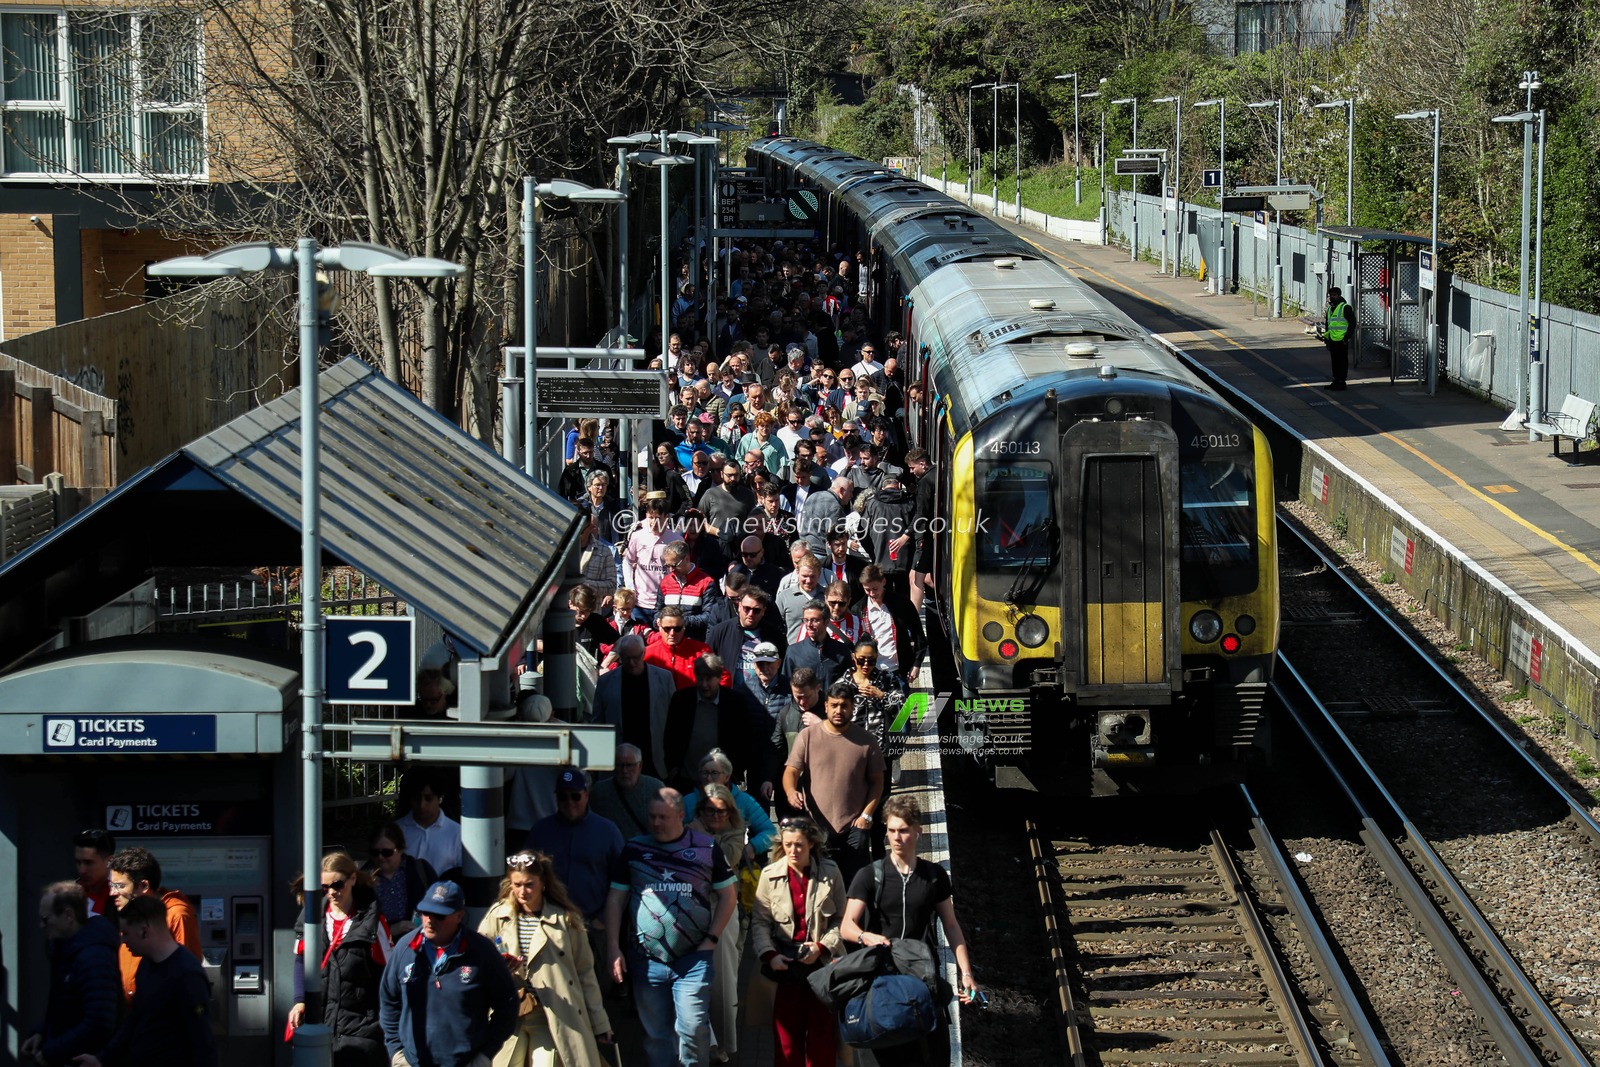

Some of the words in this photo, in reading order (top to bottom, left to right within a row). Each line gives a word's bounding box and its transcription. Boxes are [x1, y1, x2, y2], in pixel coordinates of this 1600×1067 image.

[1208, 172, 1215, 184] 1
[990, 441, 1041, 455] 450113
[1190, 434, 1240, 449] 450113
[987, 467, 1044, 479] Woking
[348, 631, 388, 689] 2
[78, 719, 145, 733] TICKETS
[78, 737, 104, 747] Card
[106, 737, 157, 748] Payments
[136, 804, 200, 817] TICKETS
[136, 821, 160, 831] Card
[162, 821, 212, 833] Payments
